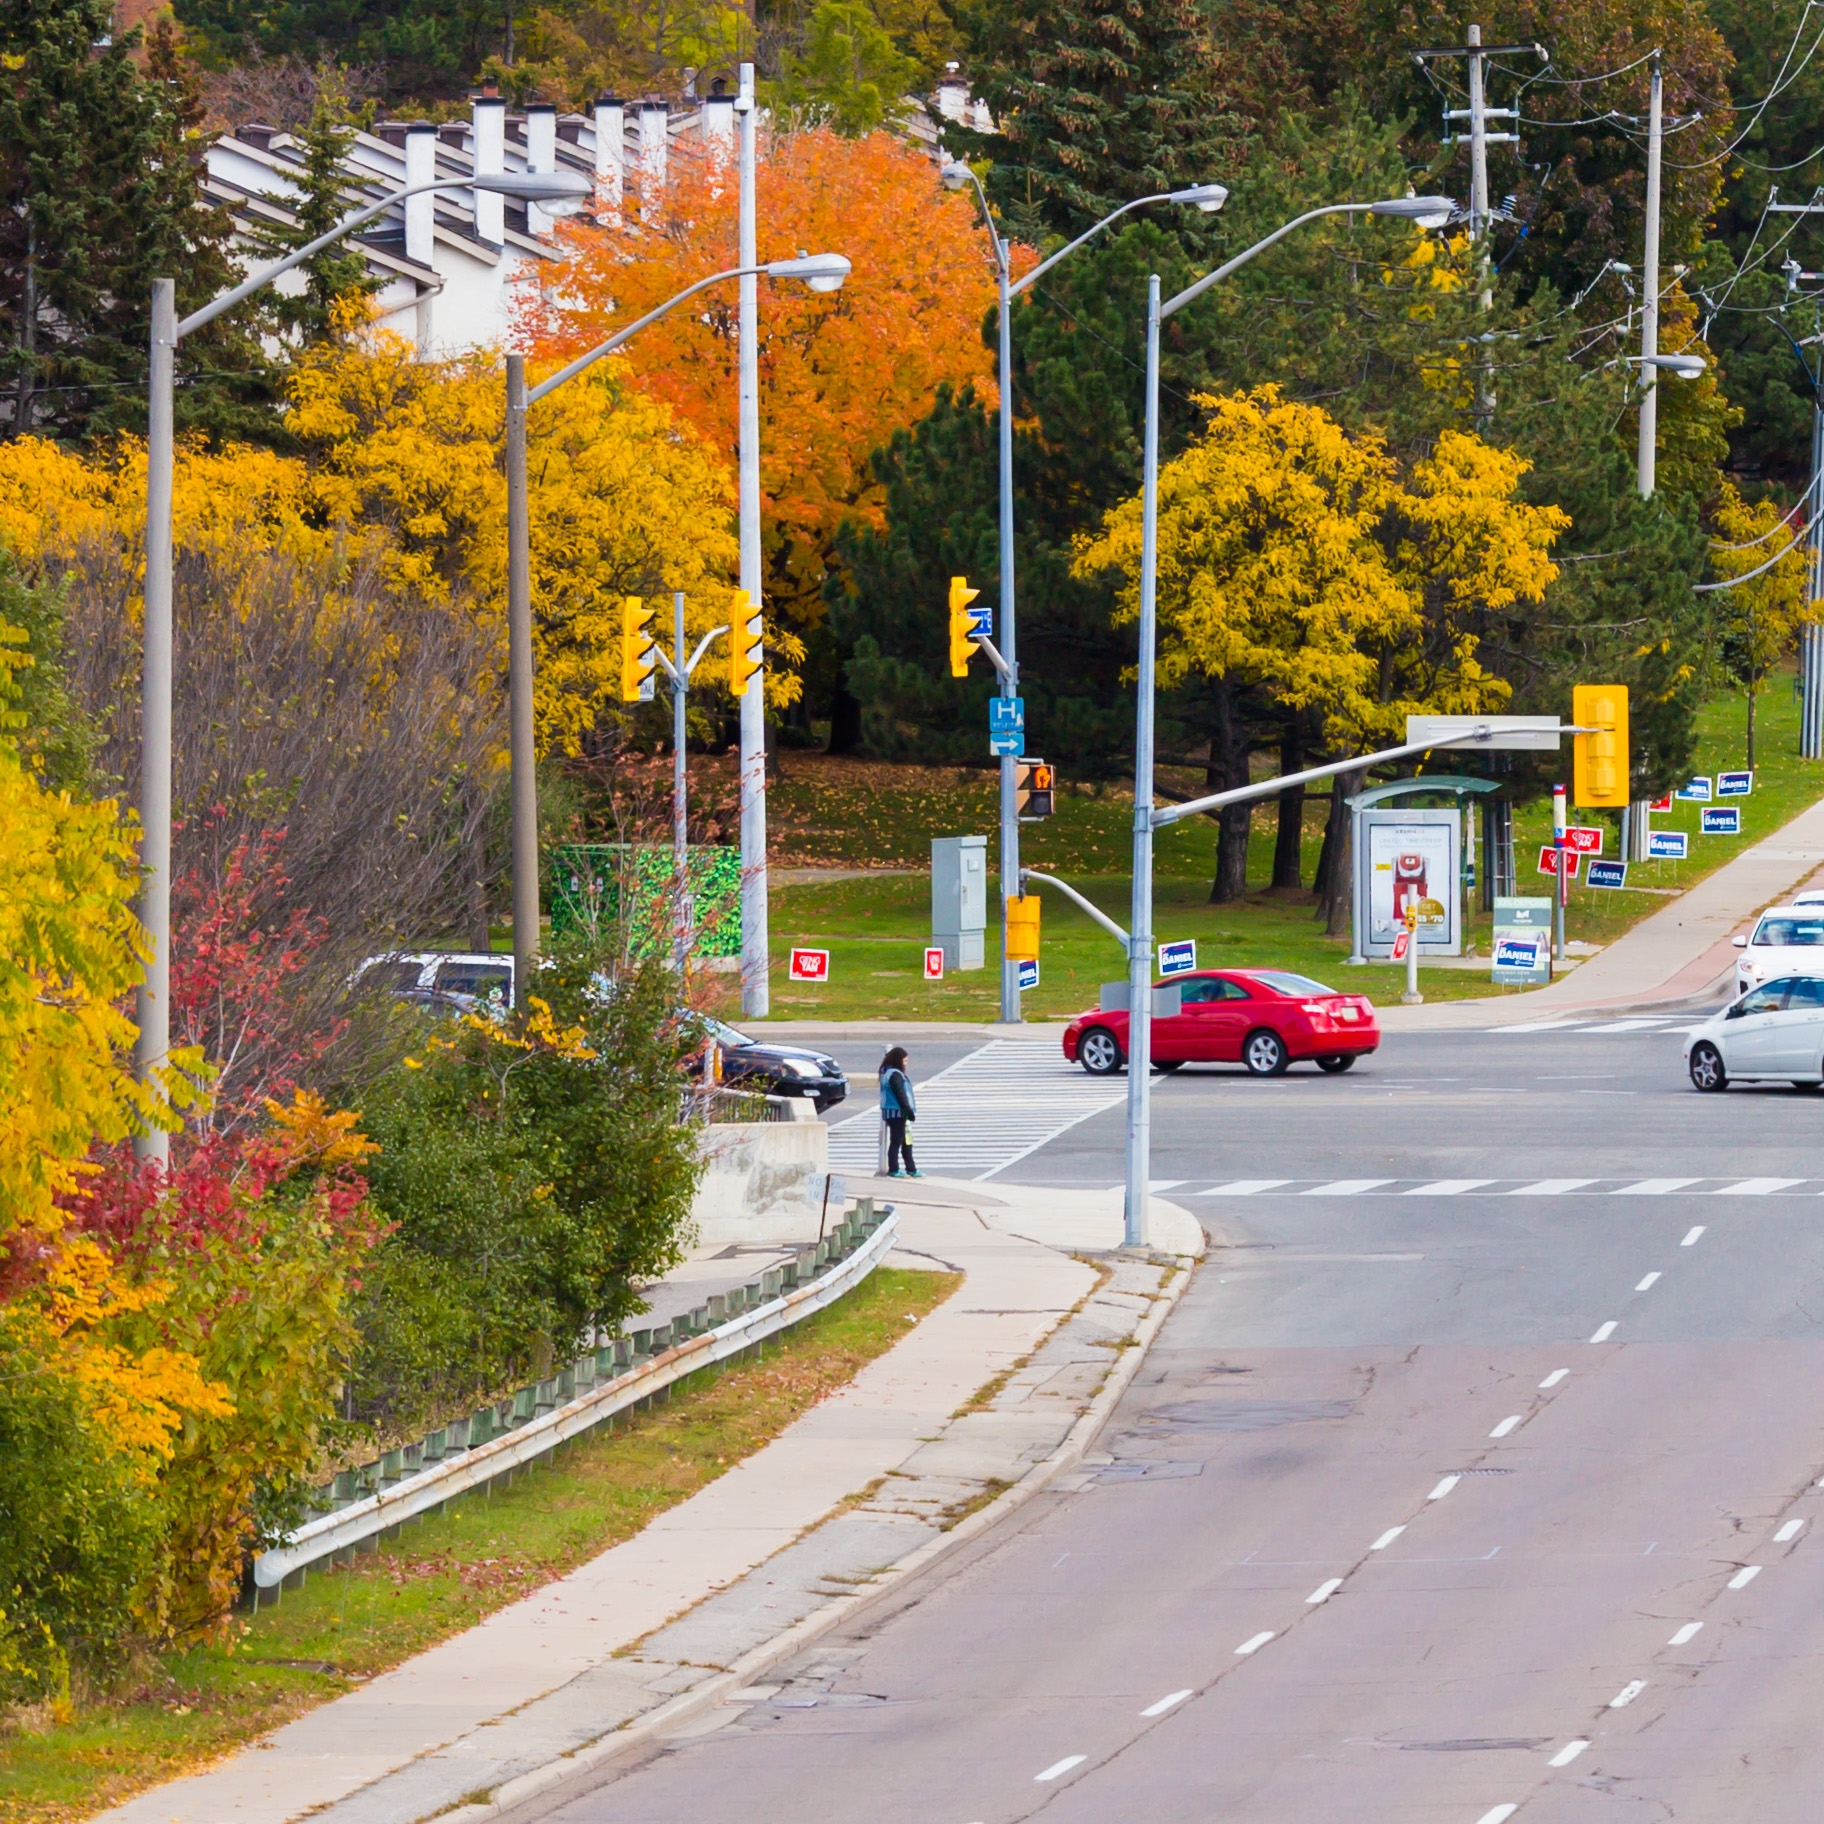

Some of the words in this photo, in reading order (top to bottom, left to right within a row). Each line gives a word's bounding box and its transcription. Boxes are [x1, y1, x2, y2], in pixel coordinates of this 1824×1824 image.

[997, 701, 1016, 719] H
[1705, 817, 1736, 826] DANIEL
[1650, 840, 1683, 851] DANIEL
[1590, 869, 1622, 880] DANIEL
[1163, 952, 1193, 966] DANIEL
[1498, 949, 1535, 961] DANIEL
